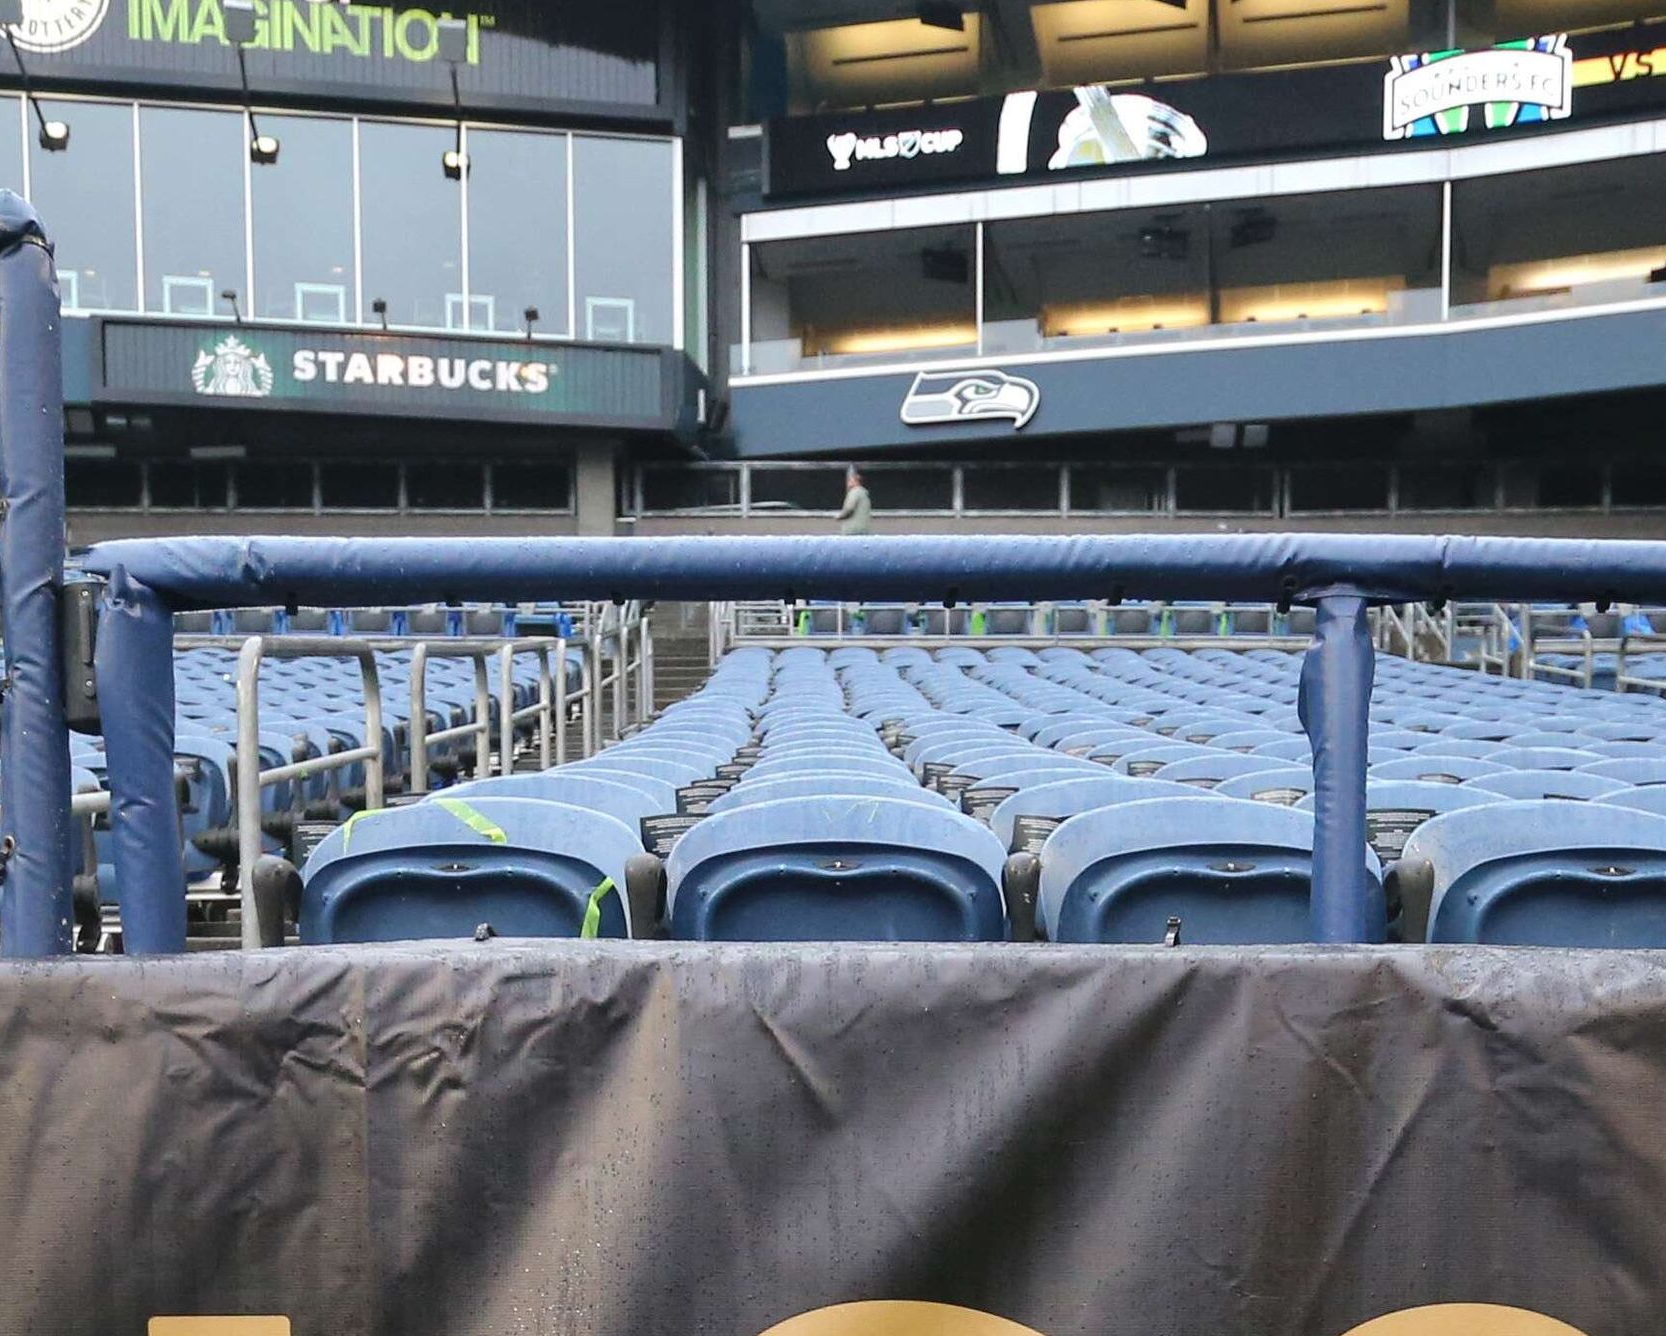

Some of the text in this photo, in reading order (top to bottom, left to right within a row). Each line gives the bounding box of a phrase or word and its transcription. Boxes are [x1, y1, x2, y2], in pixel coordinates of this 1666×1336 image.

[1609, 52, 1654, 81] VS
[1400, 73, 1555, 116] SOUNDERS FC
[855, 129, 963, 161] MLS CUP
[293, 350, 550, 393] STARBUCKS
